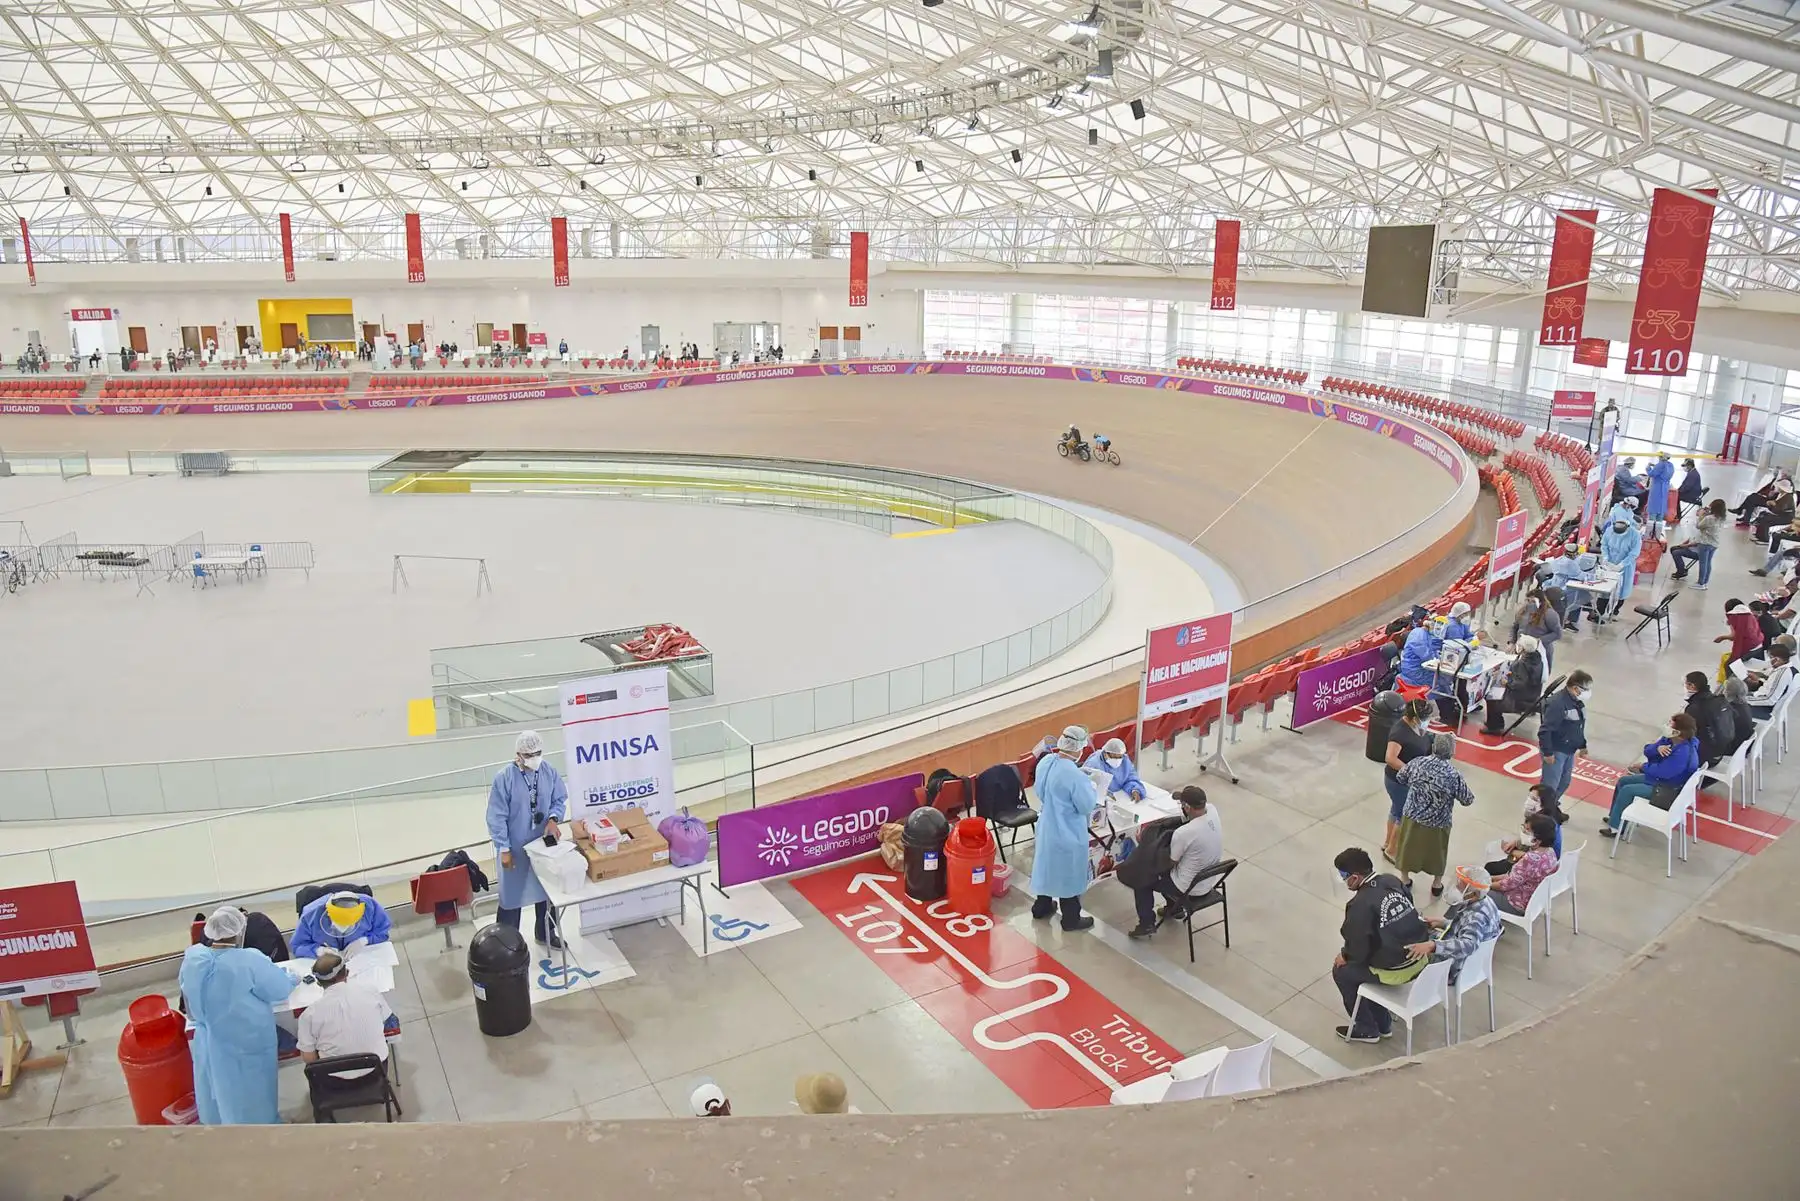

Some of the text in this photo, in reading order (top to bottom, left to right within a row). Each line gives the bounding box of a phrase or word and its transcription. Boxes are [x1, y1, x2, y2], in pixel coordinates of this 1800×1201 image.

[409, 272, 424, 281] 116
[555, 276, 569, 285] 115
[852, 295, 866, 305] 113
[1212, 296, 1233, 308] 112
[77, 310, 106, 320] SALIDA
[1544, 326, 1577, 343] 111
[1631, 348, 1684, 372] 110
[715, 367, 794, 383] SEGUIMOS JUGANDO
[965, 365, 1046, 376] SEGUIMOS JUGANDO
[466, 390, 546, 403] SEGUIMOS JUGANDO
[1212, 385, 1286, 405] SEGUIMOS JUGANDO
[213, 403, 293, 412] SEGUIMOS JUGANDO
[1148, 650, 1228, 684] ÁREA DE VACUNACIÓN
[576, 734, 659, 764] MINSA
[600, 782, 622, 792] SALUD
[623, 776, 654, 787] DEPENDE
[589, 783, 655, 803] DE TODOS
[803, 837, 851, 857] Seguimos
[836, 905, 929, 954] 107
[0, 930, 78, 957] CUNACIÓN
[1070, 1028, 1128, 1073] Block
